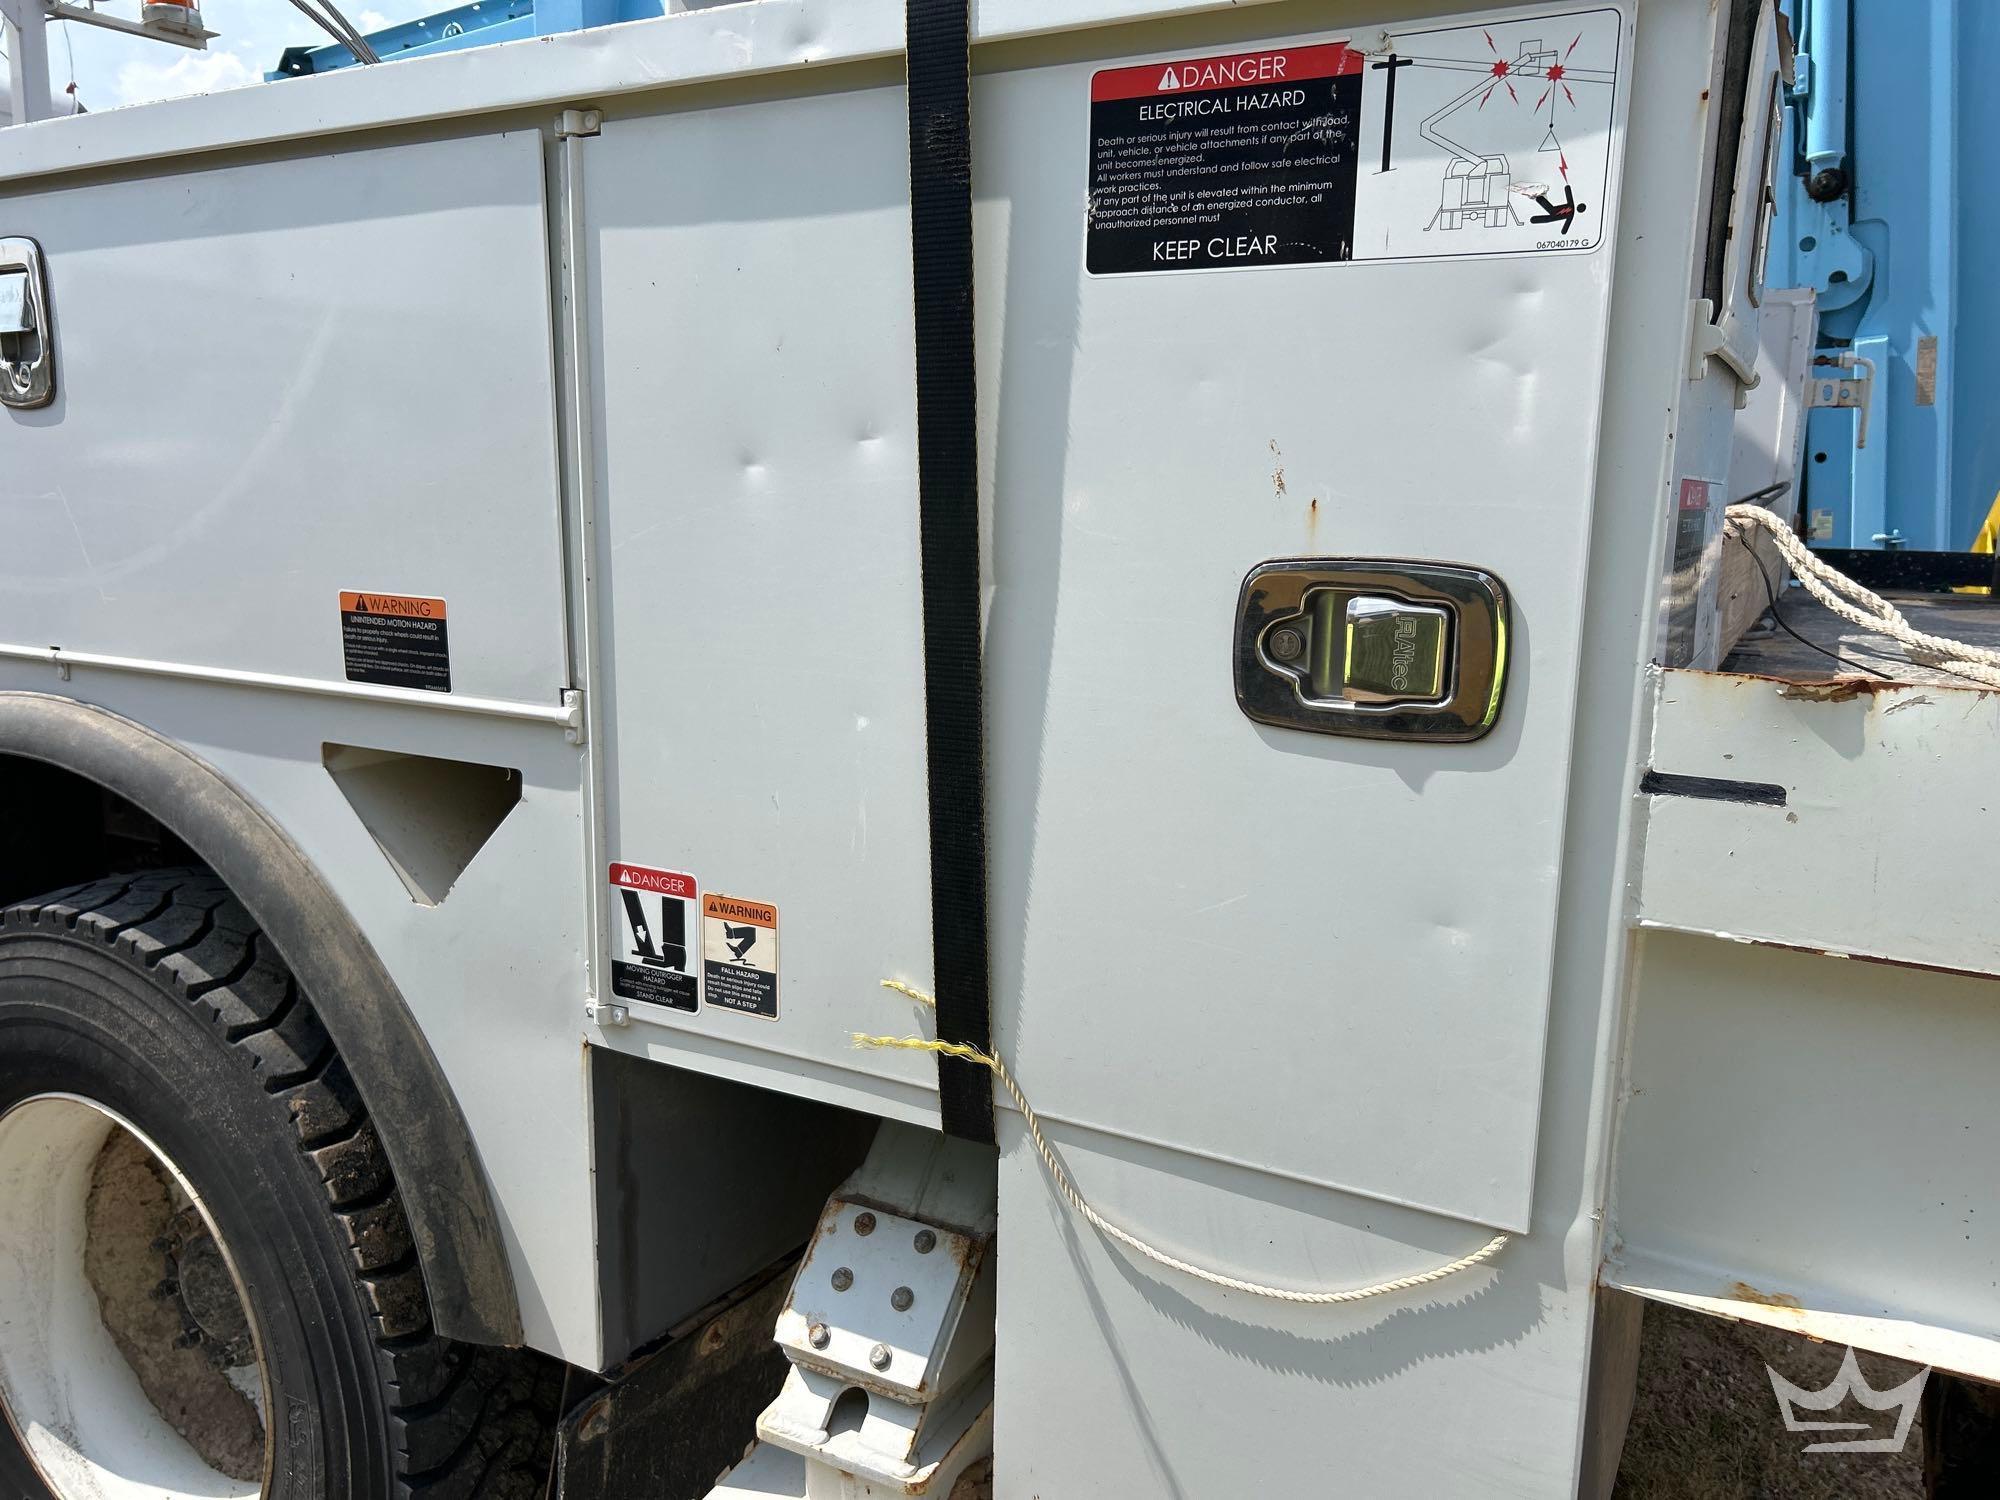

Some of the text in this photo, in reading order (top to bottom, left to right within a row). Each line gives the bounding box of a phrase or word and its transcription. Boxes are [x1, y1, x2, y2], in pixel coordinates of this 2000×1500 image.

[1182, 55, 1287, 88] DANGER
[1139, 90, 1306, 121] ELECTRICAL HAZARD
[1097, 136, 1124, 147] Death
[1126, 137, 1136, 145] or
[1138, 133, 1167, 143] serious
[1168, 130, 1192, 142] injury
[1194, 128, 1209, 138] will
[1210, 125, 1235, 137] result
[1237, 124, 1259, 134] from
[1260, 119, 1299, 132] contact
[1301, 116, 1322, 128] with
[1097, 128, 1342, 160] unit, vehicle, or vehicle attachments if any part of the
[1096, 153, 1340, 182] All workers must understand and follow safe electrical
[1097, 153, 1205, 171] unit becomes energized.
[1096, 181, 1162, 195] work practices.
[1096, 180, 1333, 207] If any part of the unit is elevated within the minimum
[1095, 192, 1323, 219] approach distance of an energized conductor, all
[1095, 212, 1220, 230] unauthorized personnel must
[1153, 234, 1278, 261] KEEP CLEAR
[1536, 238, 1589, 249] 067040179 G
[369, 598, 431, 617] WARNING
[350, 615, 438, 631] UNINTENDED MOTION HAZARD
[1391, 630, 1416, 691] Altec
[632, 871, 685, 893] DANGER
[719, 902, 772, 922] WARNING
[625, 964, 683, 982] MOVING OUTRIGGER
[643, 975, 666, 986] HAZARD
[721, 967, 760, 980] FALL HAZARD
[637, 991, 674, 1004] STAND CLEAR
[724, 997, 736, 1005] NOT
[742, 1000, 757, 1009] STEP
